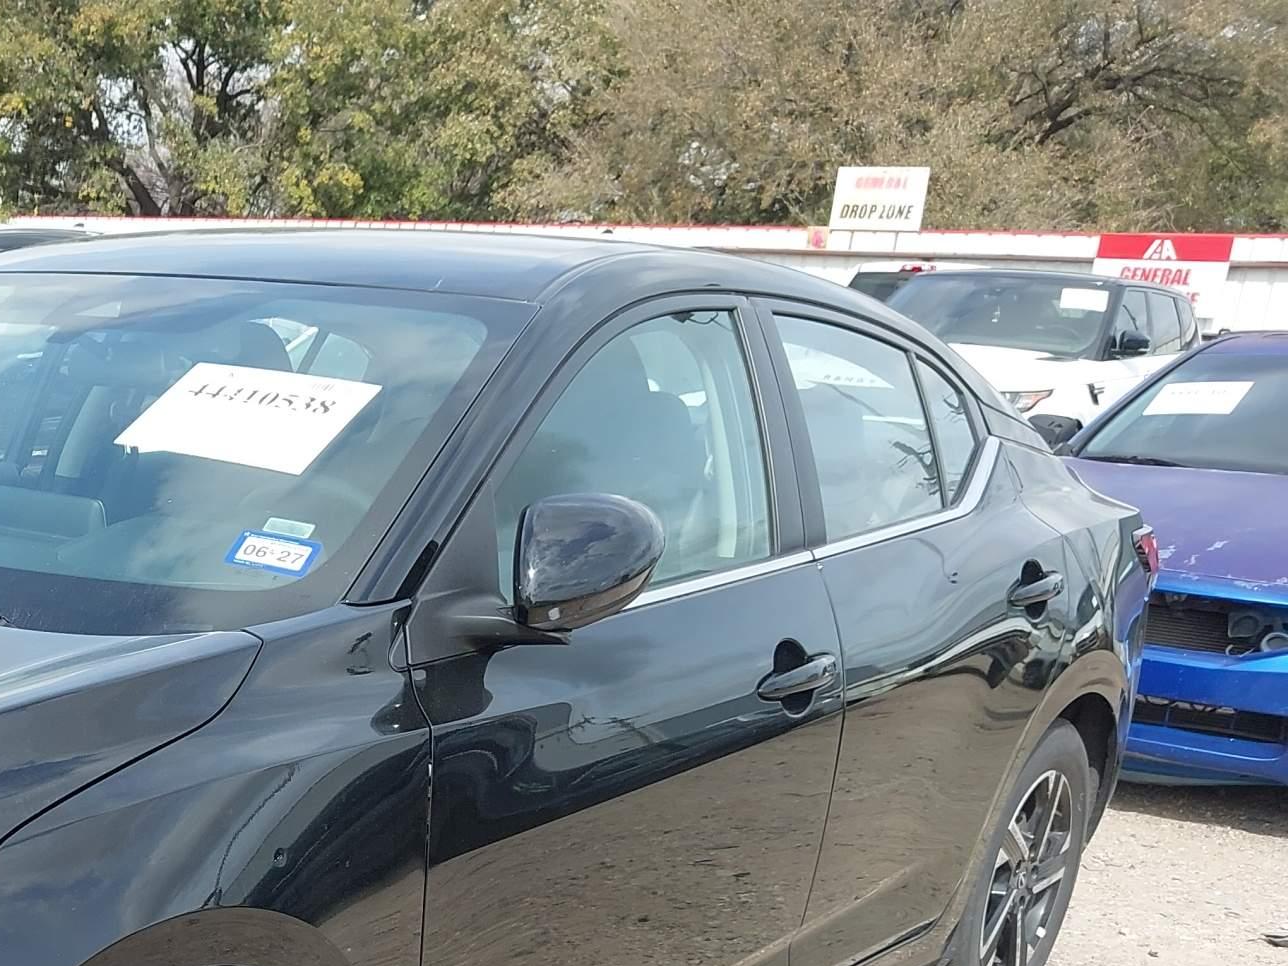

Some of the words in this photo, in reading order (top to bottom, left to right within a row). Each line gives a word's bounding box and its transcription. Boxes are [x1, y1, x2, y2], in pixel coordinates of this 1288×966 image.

[840, 204, 878, 220] DROP
[878, 204, 914, 220] ZONE
[1119, 266, 1192, 286] GENERAL
[186, 382, 338, 414] 44410538
[243, 544, 269, 558] 06
[276, 550, 305, 564] 27
